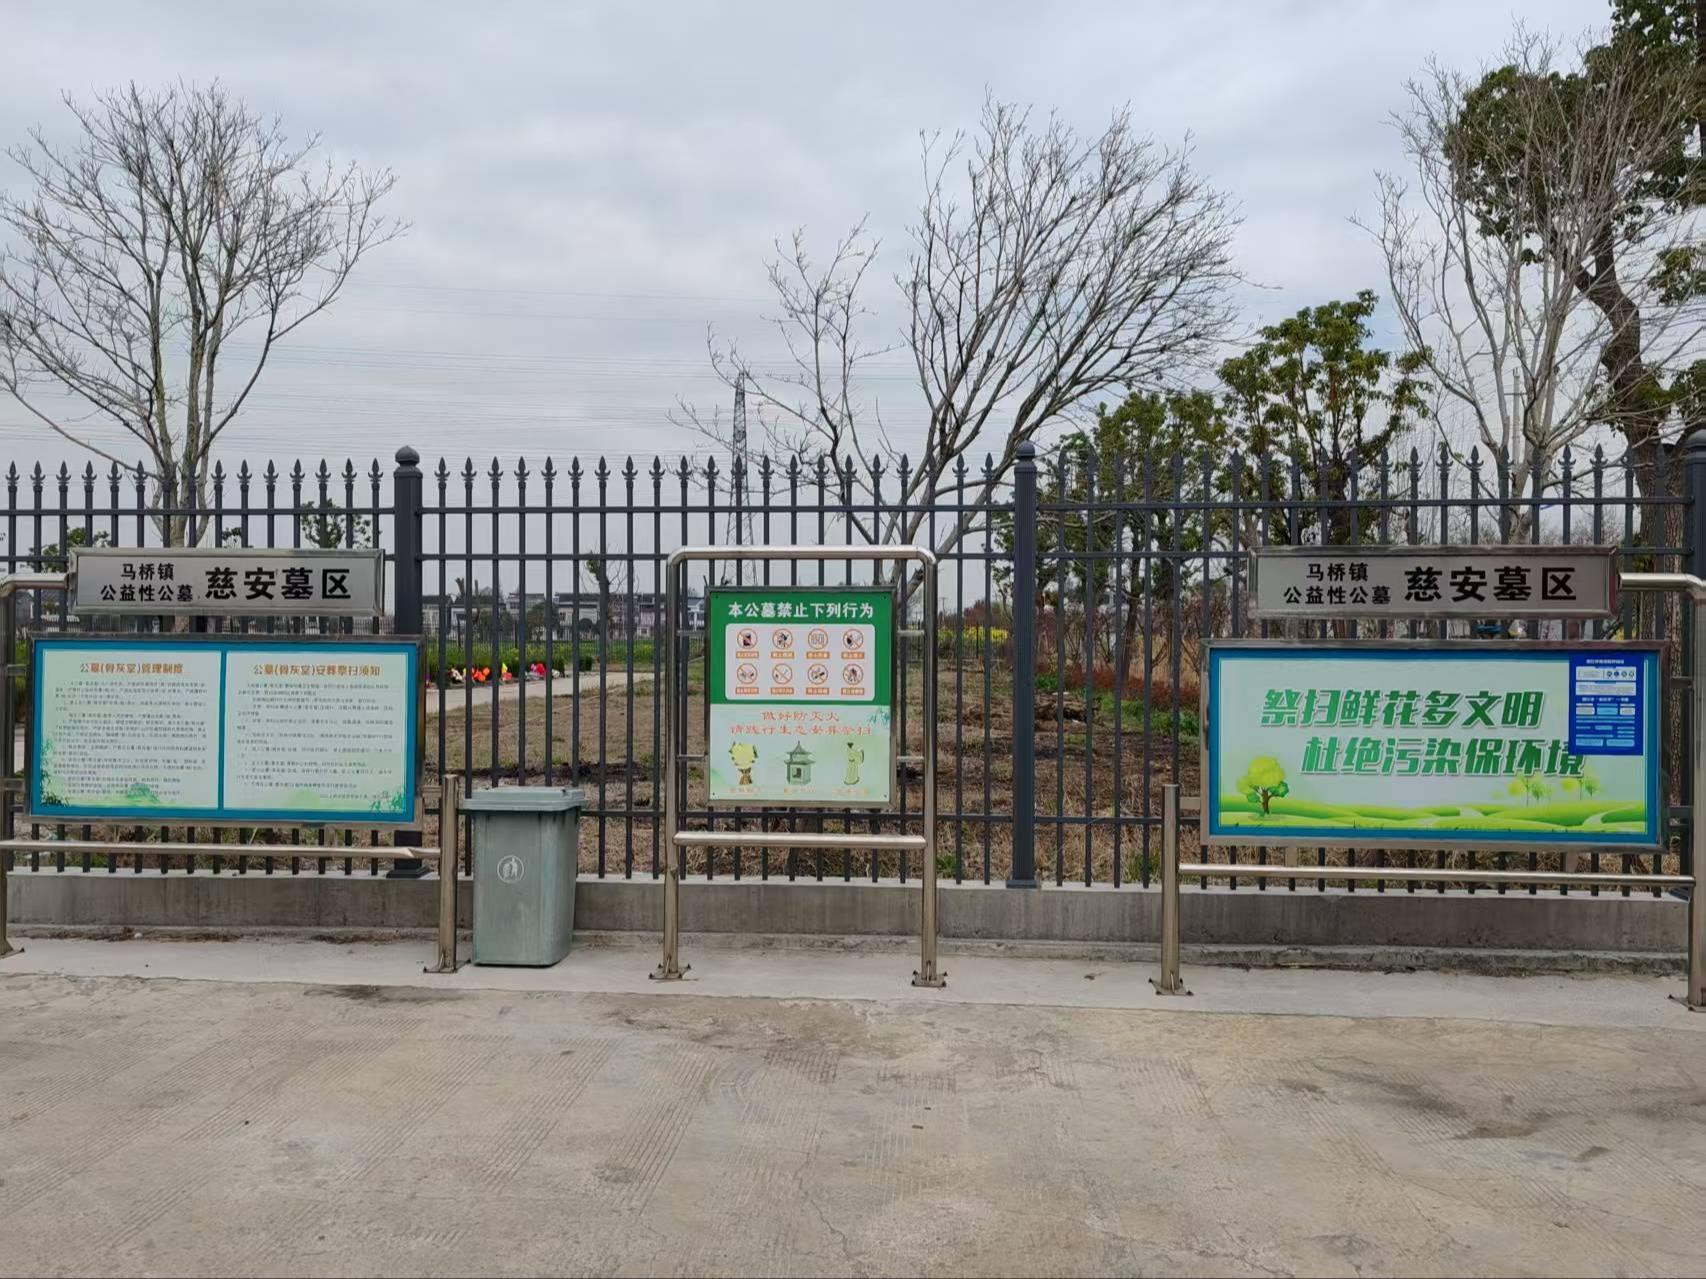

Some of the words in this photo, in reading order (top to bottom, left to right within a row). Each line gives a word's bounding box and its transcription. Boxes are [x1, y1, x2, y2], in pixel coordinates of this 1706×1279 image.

[121, 563, 174, 581] 马桥镇
[1306, 562, 1369, 581] 马桥镇
[205, 567, 351, 599] 慈安墓区
[1405, 566, 1577, 602] 慈安墓区
[101, 584, 193, 602] 公益性公墓
[1284, 586, 1391, 605] 公益性公墓
[728, 601, 874, 618] 本公墓禁止下列行为
[1260, 688, 1546, 729] 祭扫鲜花多文明
[1300, 736, 1586, 777] 杜绝污染保环境
